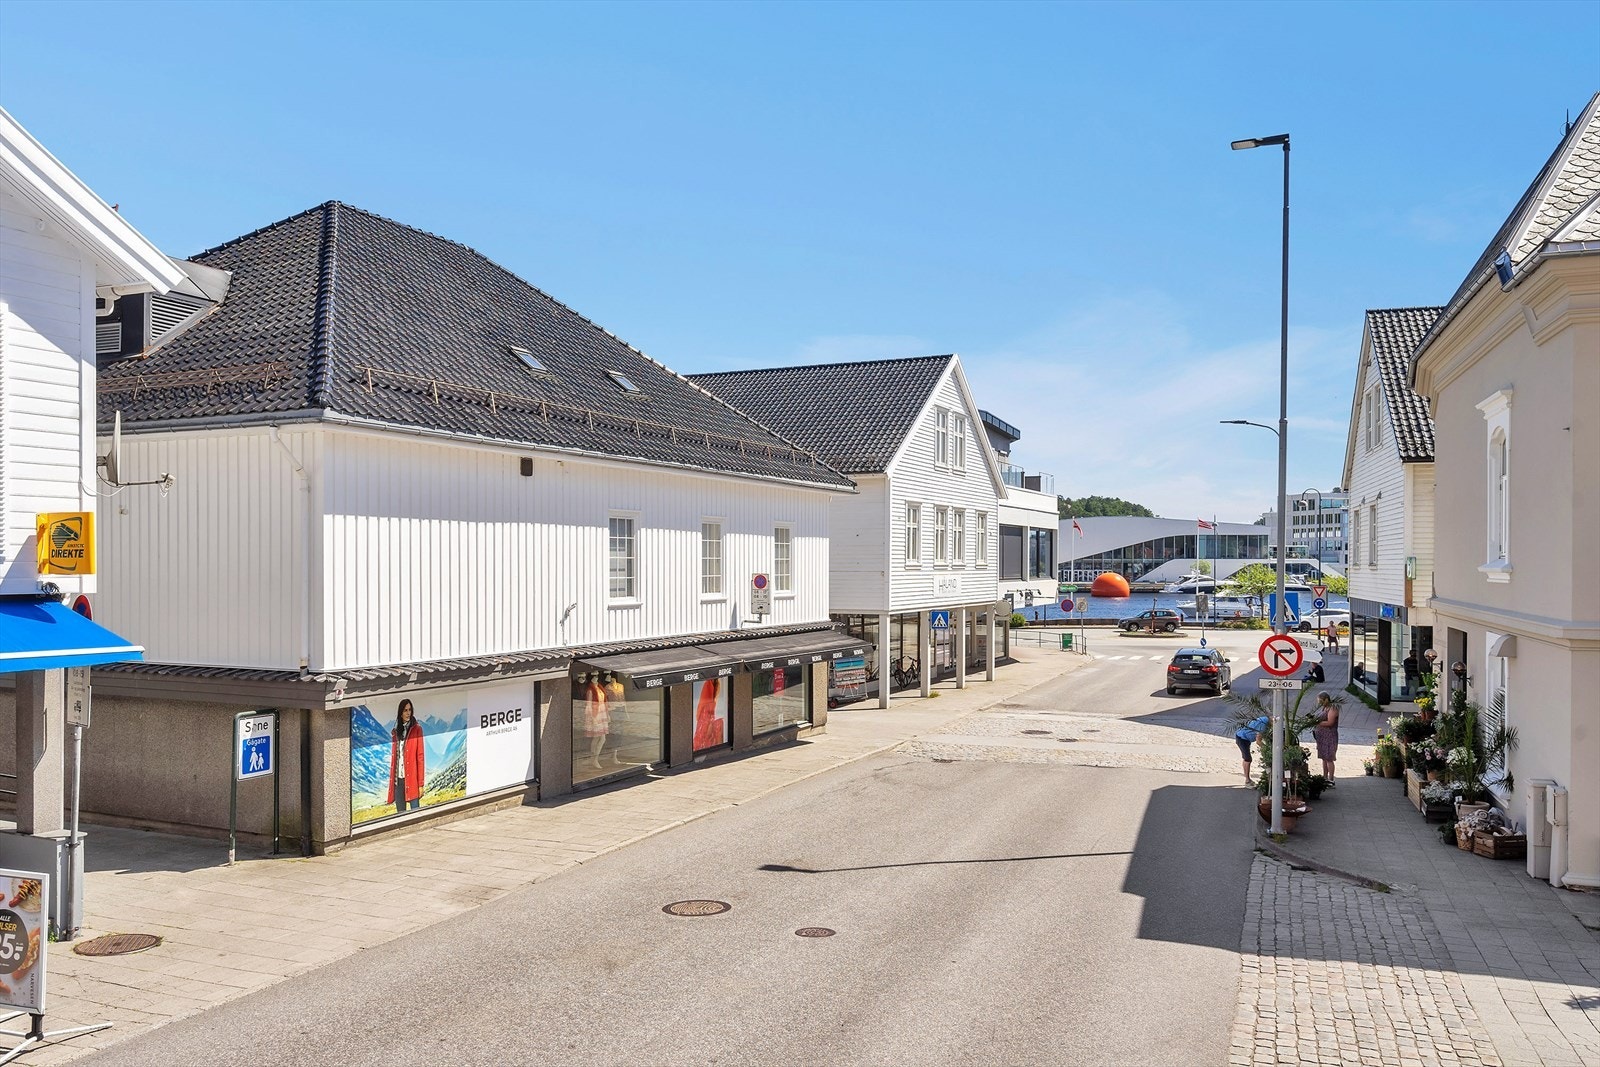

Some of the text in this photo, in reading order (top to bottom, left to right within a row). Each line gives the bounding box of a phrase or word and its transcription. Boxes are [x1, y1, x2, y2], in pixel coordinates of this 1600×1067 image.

[51, 549, 84, 558] DIREKTE
[761, 661, 774, 669] BERGE
[718, 667, 732, 676] BERGE
[684, 673, 699, 681] BERGE
[646, 678, 663, 688] BERGE
[480, 708, 522, 729] BERGE
